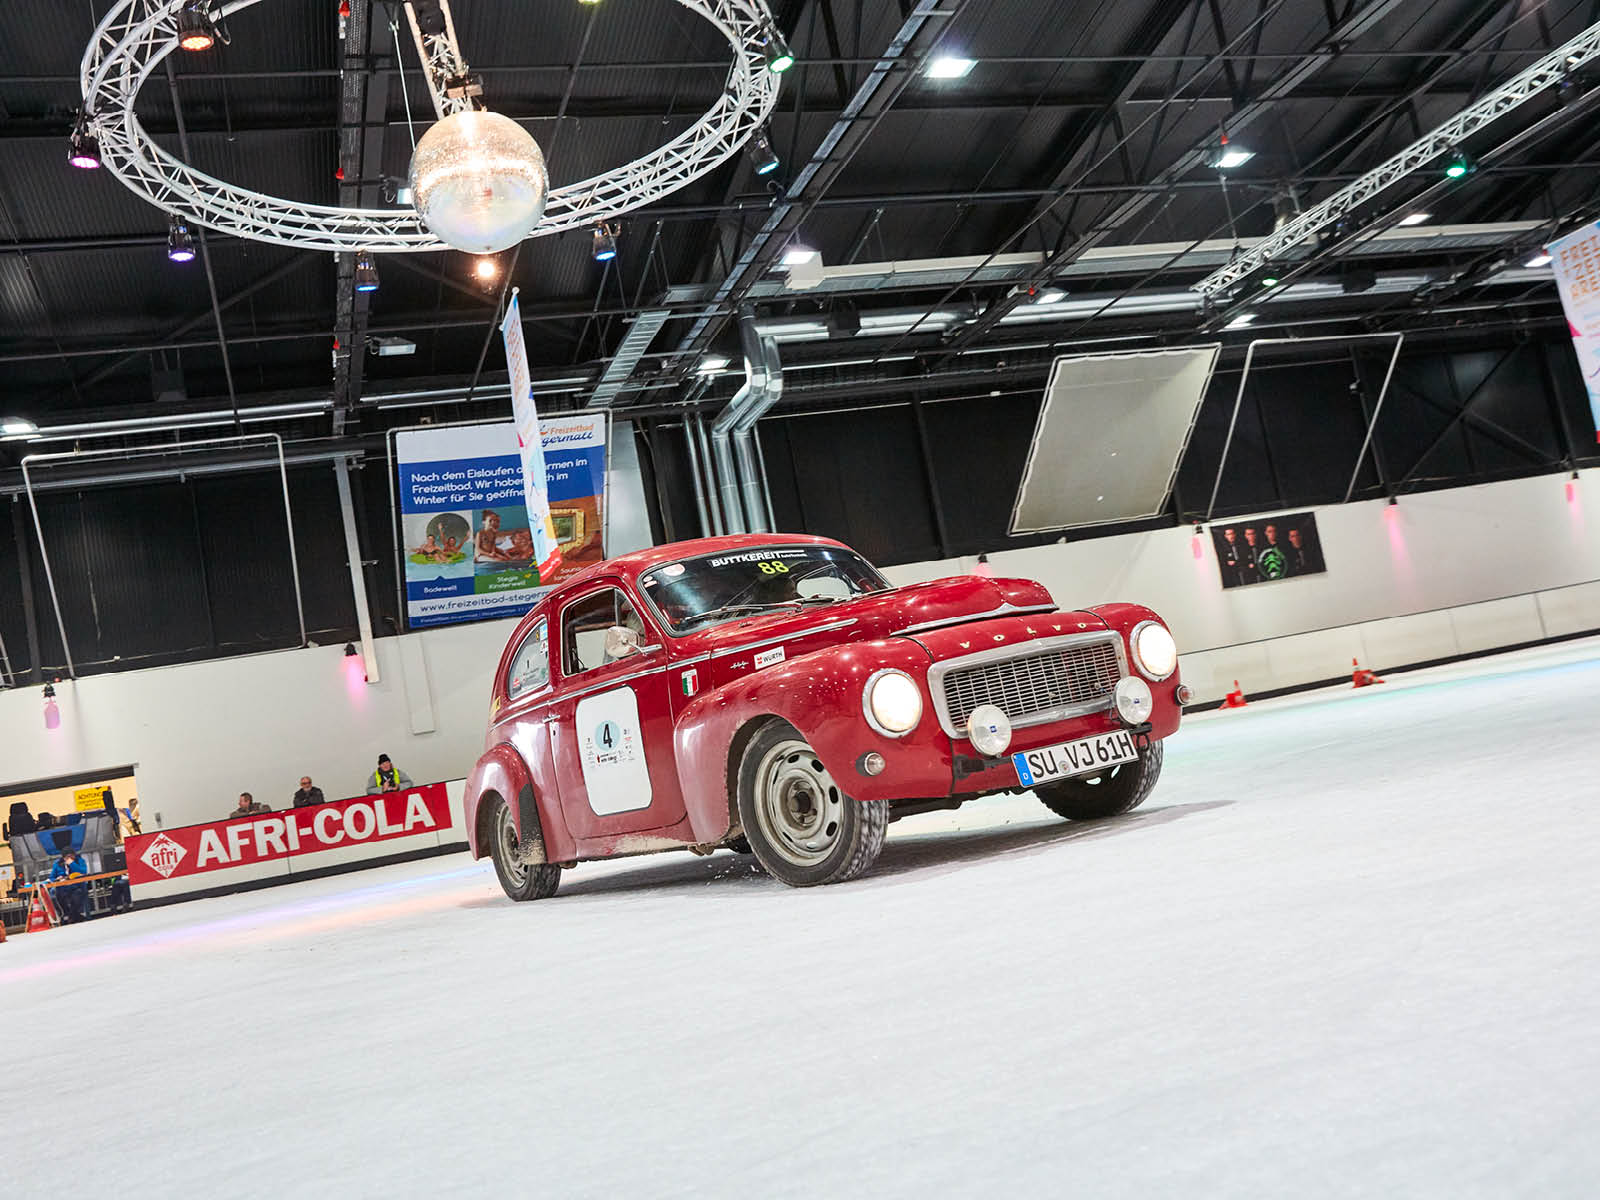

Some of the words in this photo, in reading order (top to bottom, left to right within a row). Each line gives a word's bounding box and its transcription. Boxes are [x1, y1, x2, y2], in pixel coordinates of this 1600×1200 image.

[441, 470, 466, 480] dem
[467, 467, 515, 479] Eislaufen
[575, 458, 588, 467] im
[475, 479, 493, 489] Wir
[556, 472, 569, 482] im
[413, 494, 447, 505] Winter
[450, 491, 466, 503] für
[468, 490, 484, 501] Sie
[711, 550, 781, 567] BUTTKEREIT
[757, 560, 789, 575] 88
[959, 622, 1087, 649] VOLVO
[603, 723, 613, 749] 4
[1022, 772, 1029, 780] D
[1028, 750, 1059, 779] SU
[196, 793, 436, 868] AFRI-COLA
[151, 846, 178, 867] afri
